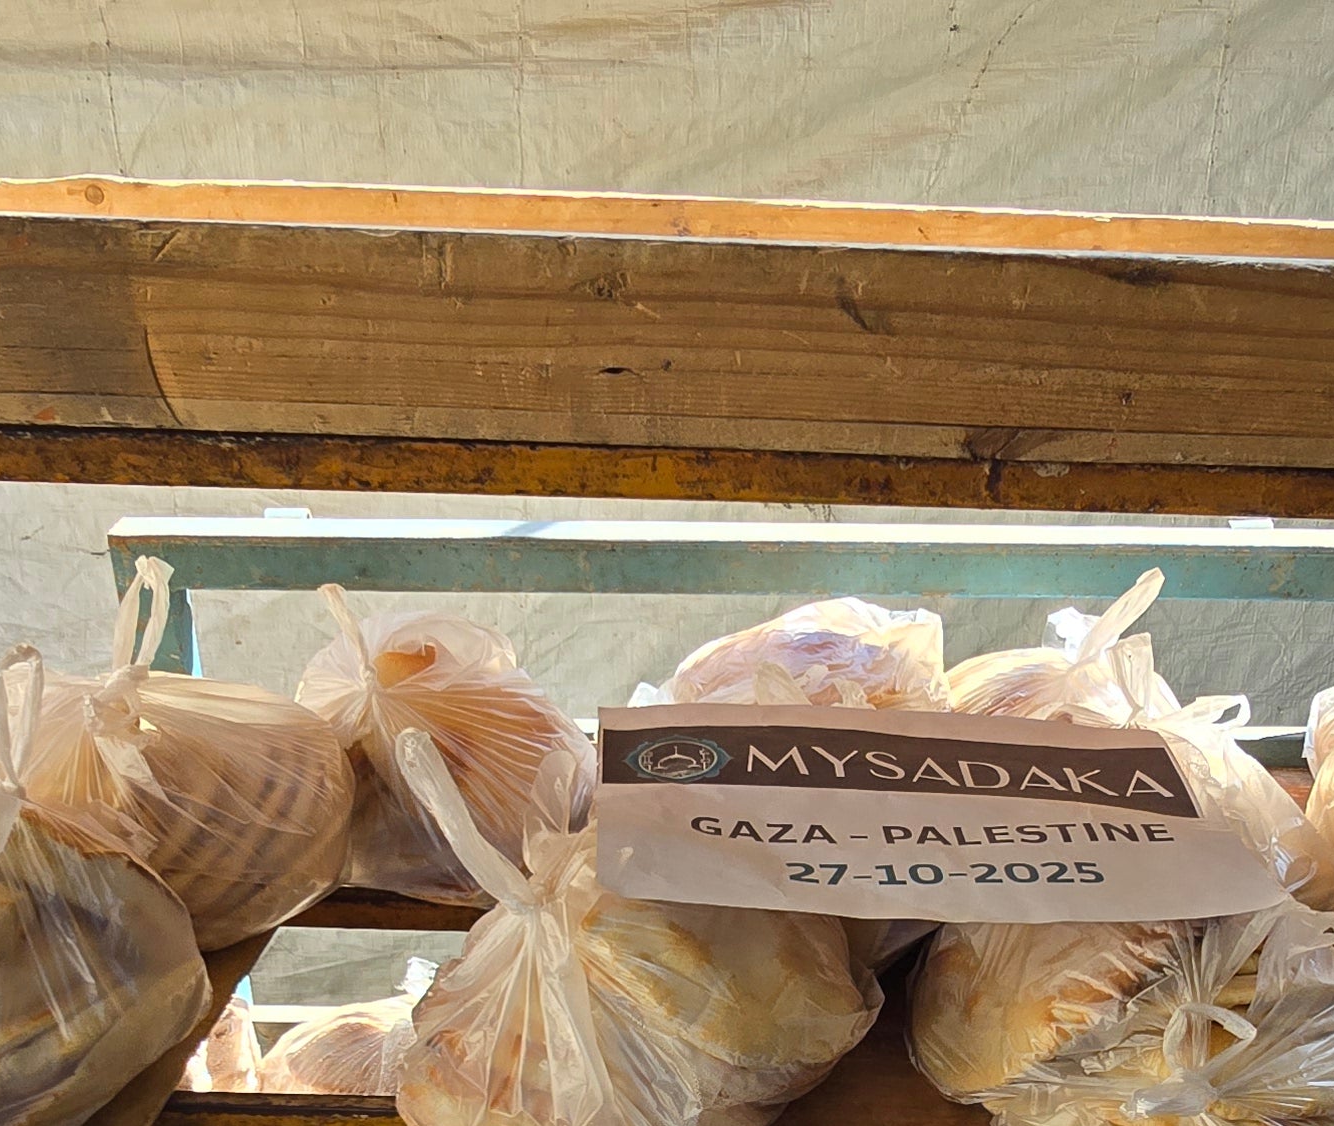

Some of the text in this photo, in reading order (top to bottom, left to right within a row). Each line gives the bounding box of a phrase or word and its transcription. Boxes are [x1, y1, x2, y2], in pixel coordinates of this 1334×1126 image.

[747, 745, 1175, 798] MYSADAKA
[691, 816, 838, 845] GAZA
[882, 821, 1176, 847] PALESTINE
[785, 862, 1105, 887] 27-10-2025
